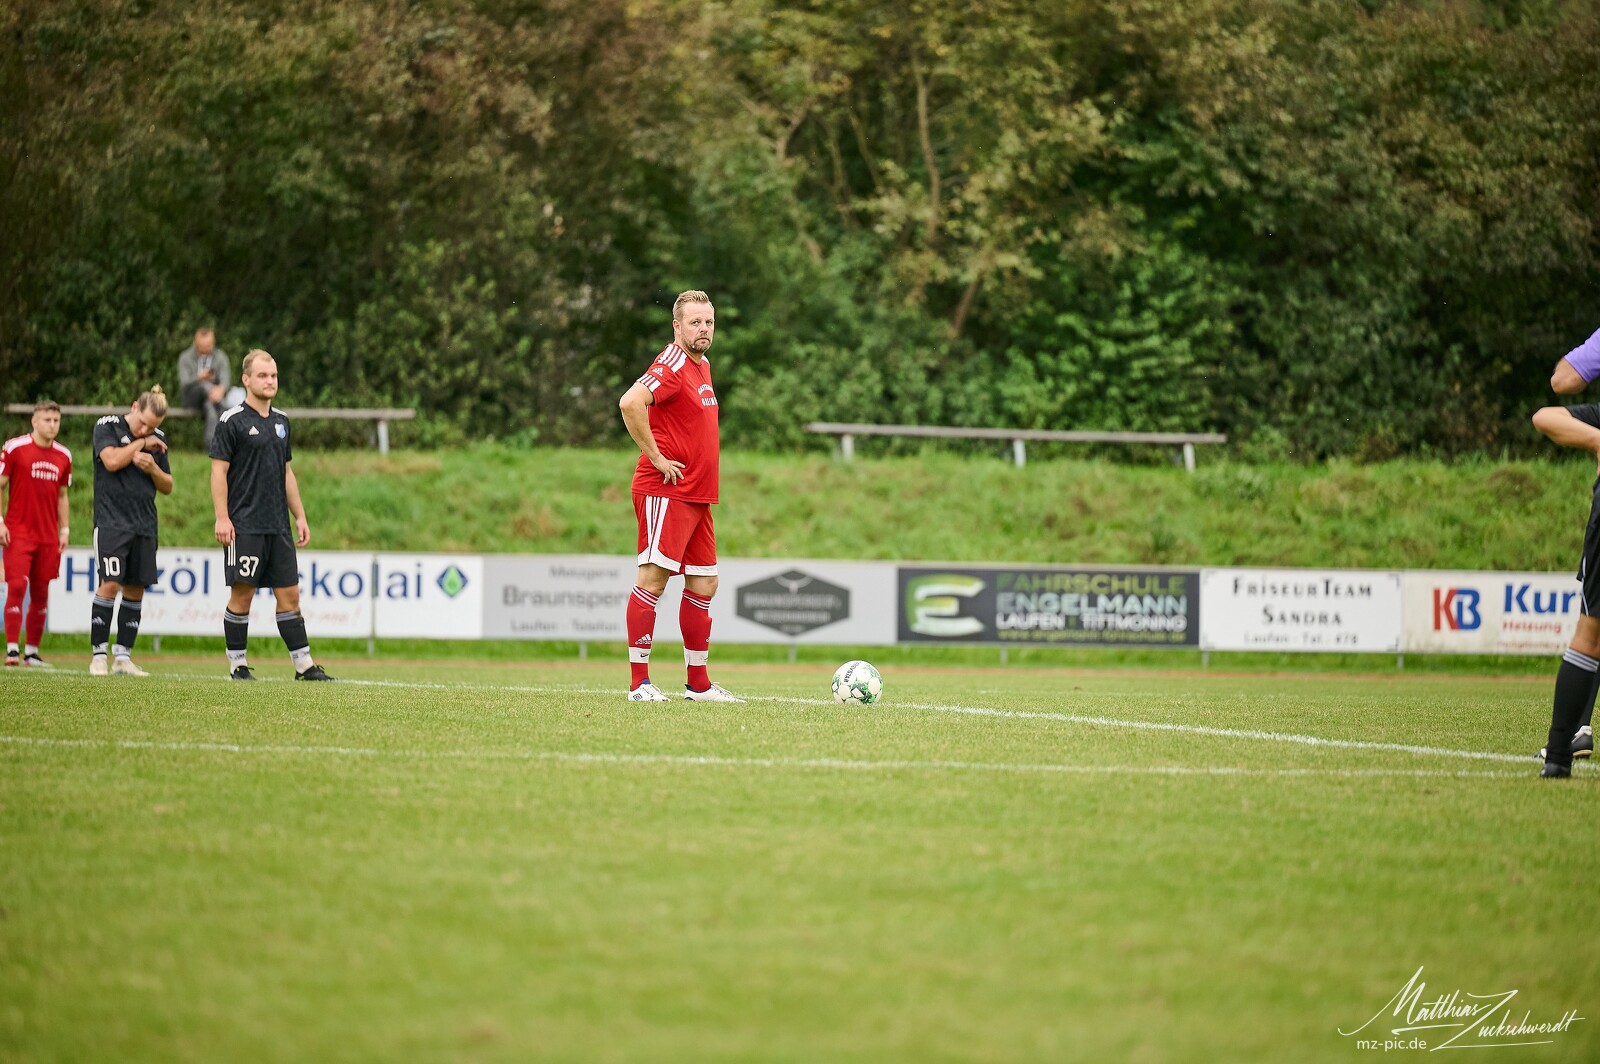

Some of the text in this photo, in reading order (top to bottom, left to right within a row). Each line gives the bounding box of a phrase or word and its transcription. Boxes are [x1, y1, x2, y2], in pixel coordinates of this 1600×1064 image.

[66, 555, 421, 600] Hzöl kolai
[103, 556, 120, 577] 10
[239, 555, 260, 577] 37
[997, 573, 1186, 595] FAHRSCHULE
[502, 584, 668, 611] Braunsper
[996, 592, 1187, 616] ENGELMANN
[1503, 584, 1582, 614] Kur
[1433, 588, 1482, 631] KB
[996, 612, 1187, 632] LAUFEN TITTMONING
[1503, 620, 1562, 635] Heizung
